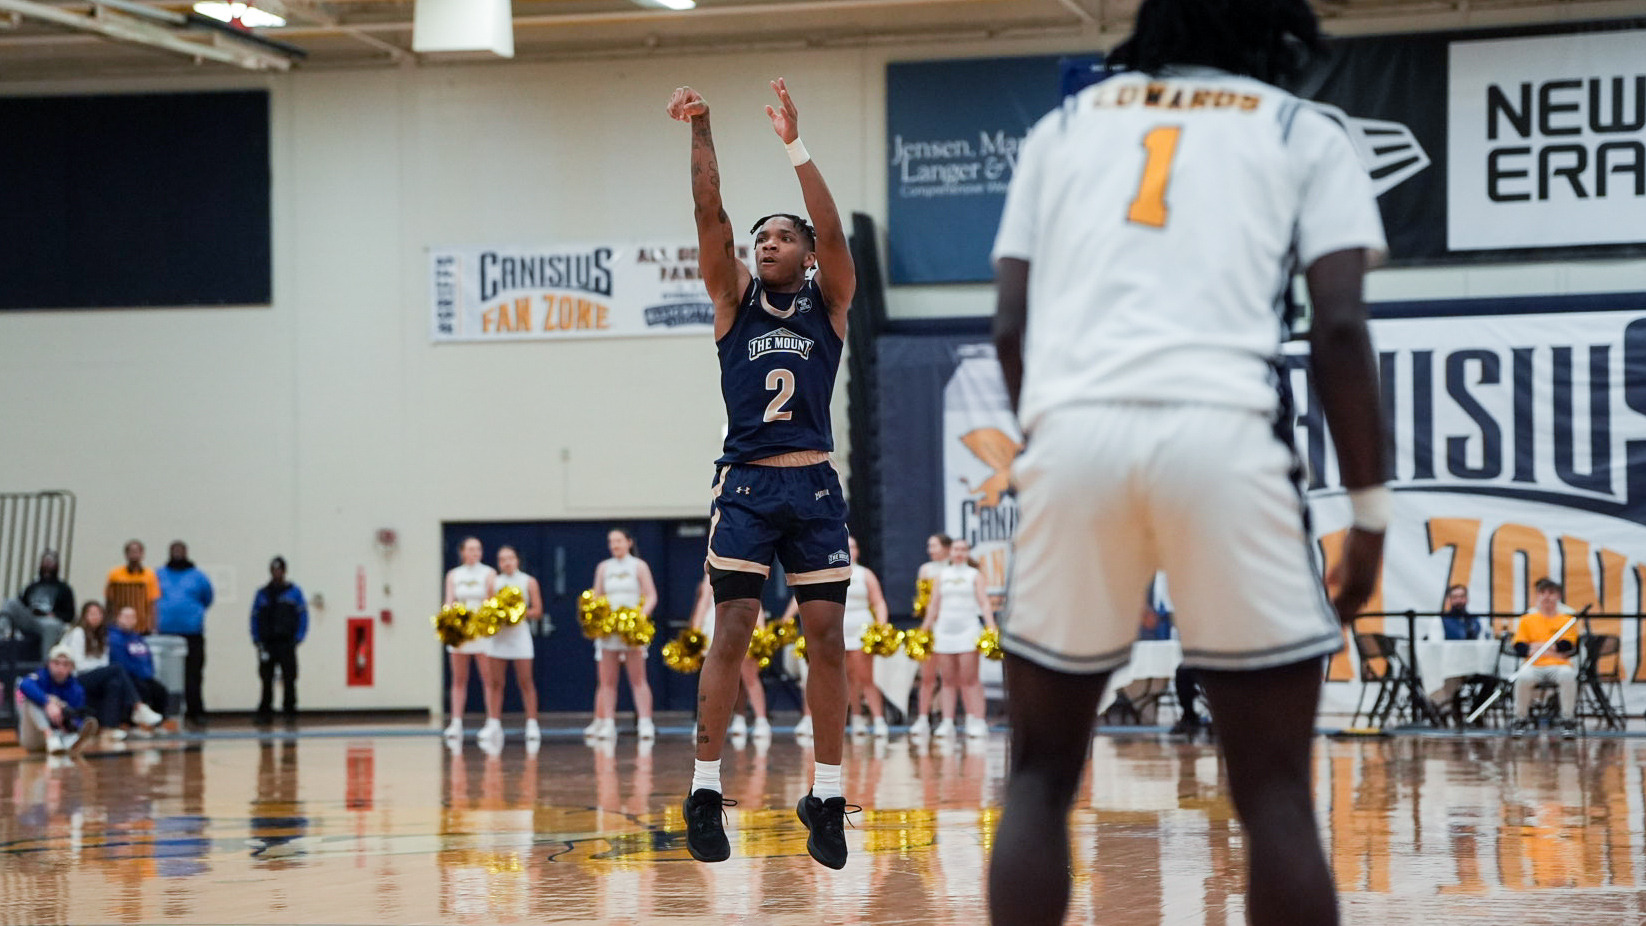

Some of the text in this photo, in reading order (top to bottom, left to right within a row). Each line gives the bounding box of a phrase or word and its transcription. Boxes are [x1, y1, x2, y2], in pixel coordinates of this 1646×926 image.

[1487, 75, 1646, 140] NEW
[901, 154, 980, 184] Langer
[1125, 125, 1183, 229] 1
[1487, 140, 1646, 204] ERA
[480, 247, 613, 301] CANISIUS
[481, 296, 532, 334] FAN
[543, 294, 611, 332] ZONE
[750, 336, 812, 356] THE MOUNT
[763, 368, 796, 423] 2
